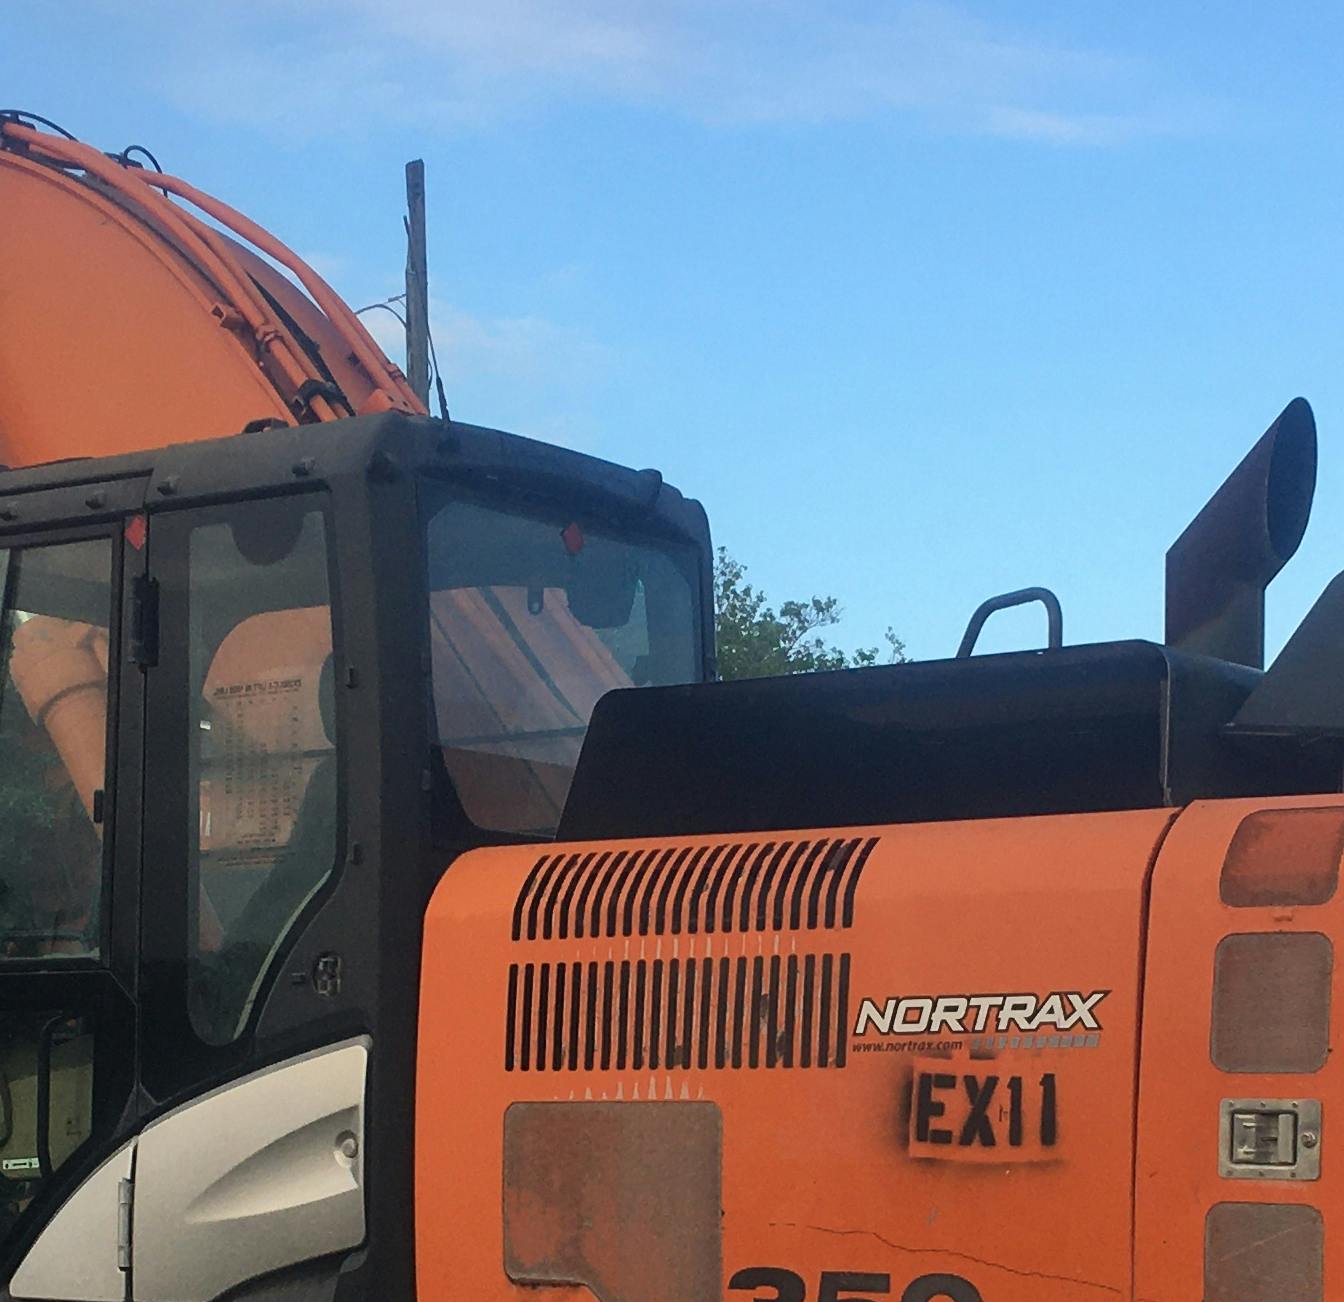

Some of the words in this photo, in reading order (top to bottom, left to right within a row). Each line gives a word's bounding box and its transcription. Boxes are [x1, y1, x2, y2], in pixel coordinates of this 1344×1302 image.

[853, 990, 1111, 1035] NORTRAX
[852, 1039, 963, 1052] www.nortrax.com
[917, 1072, 1057, 1147] EX11
